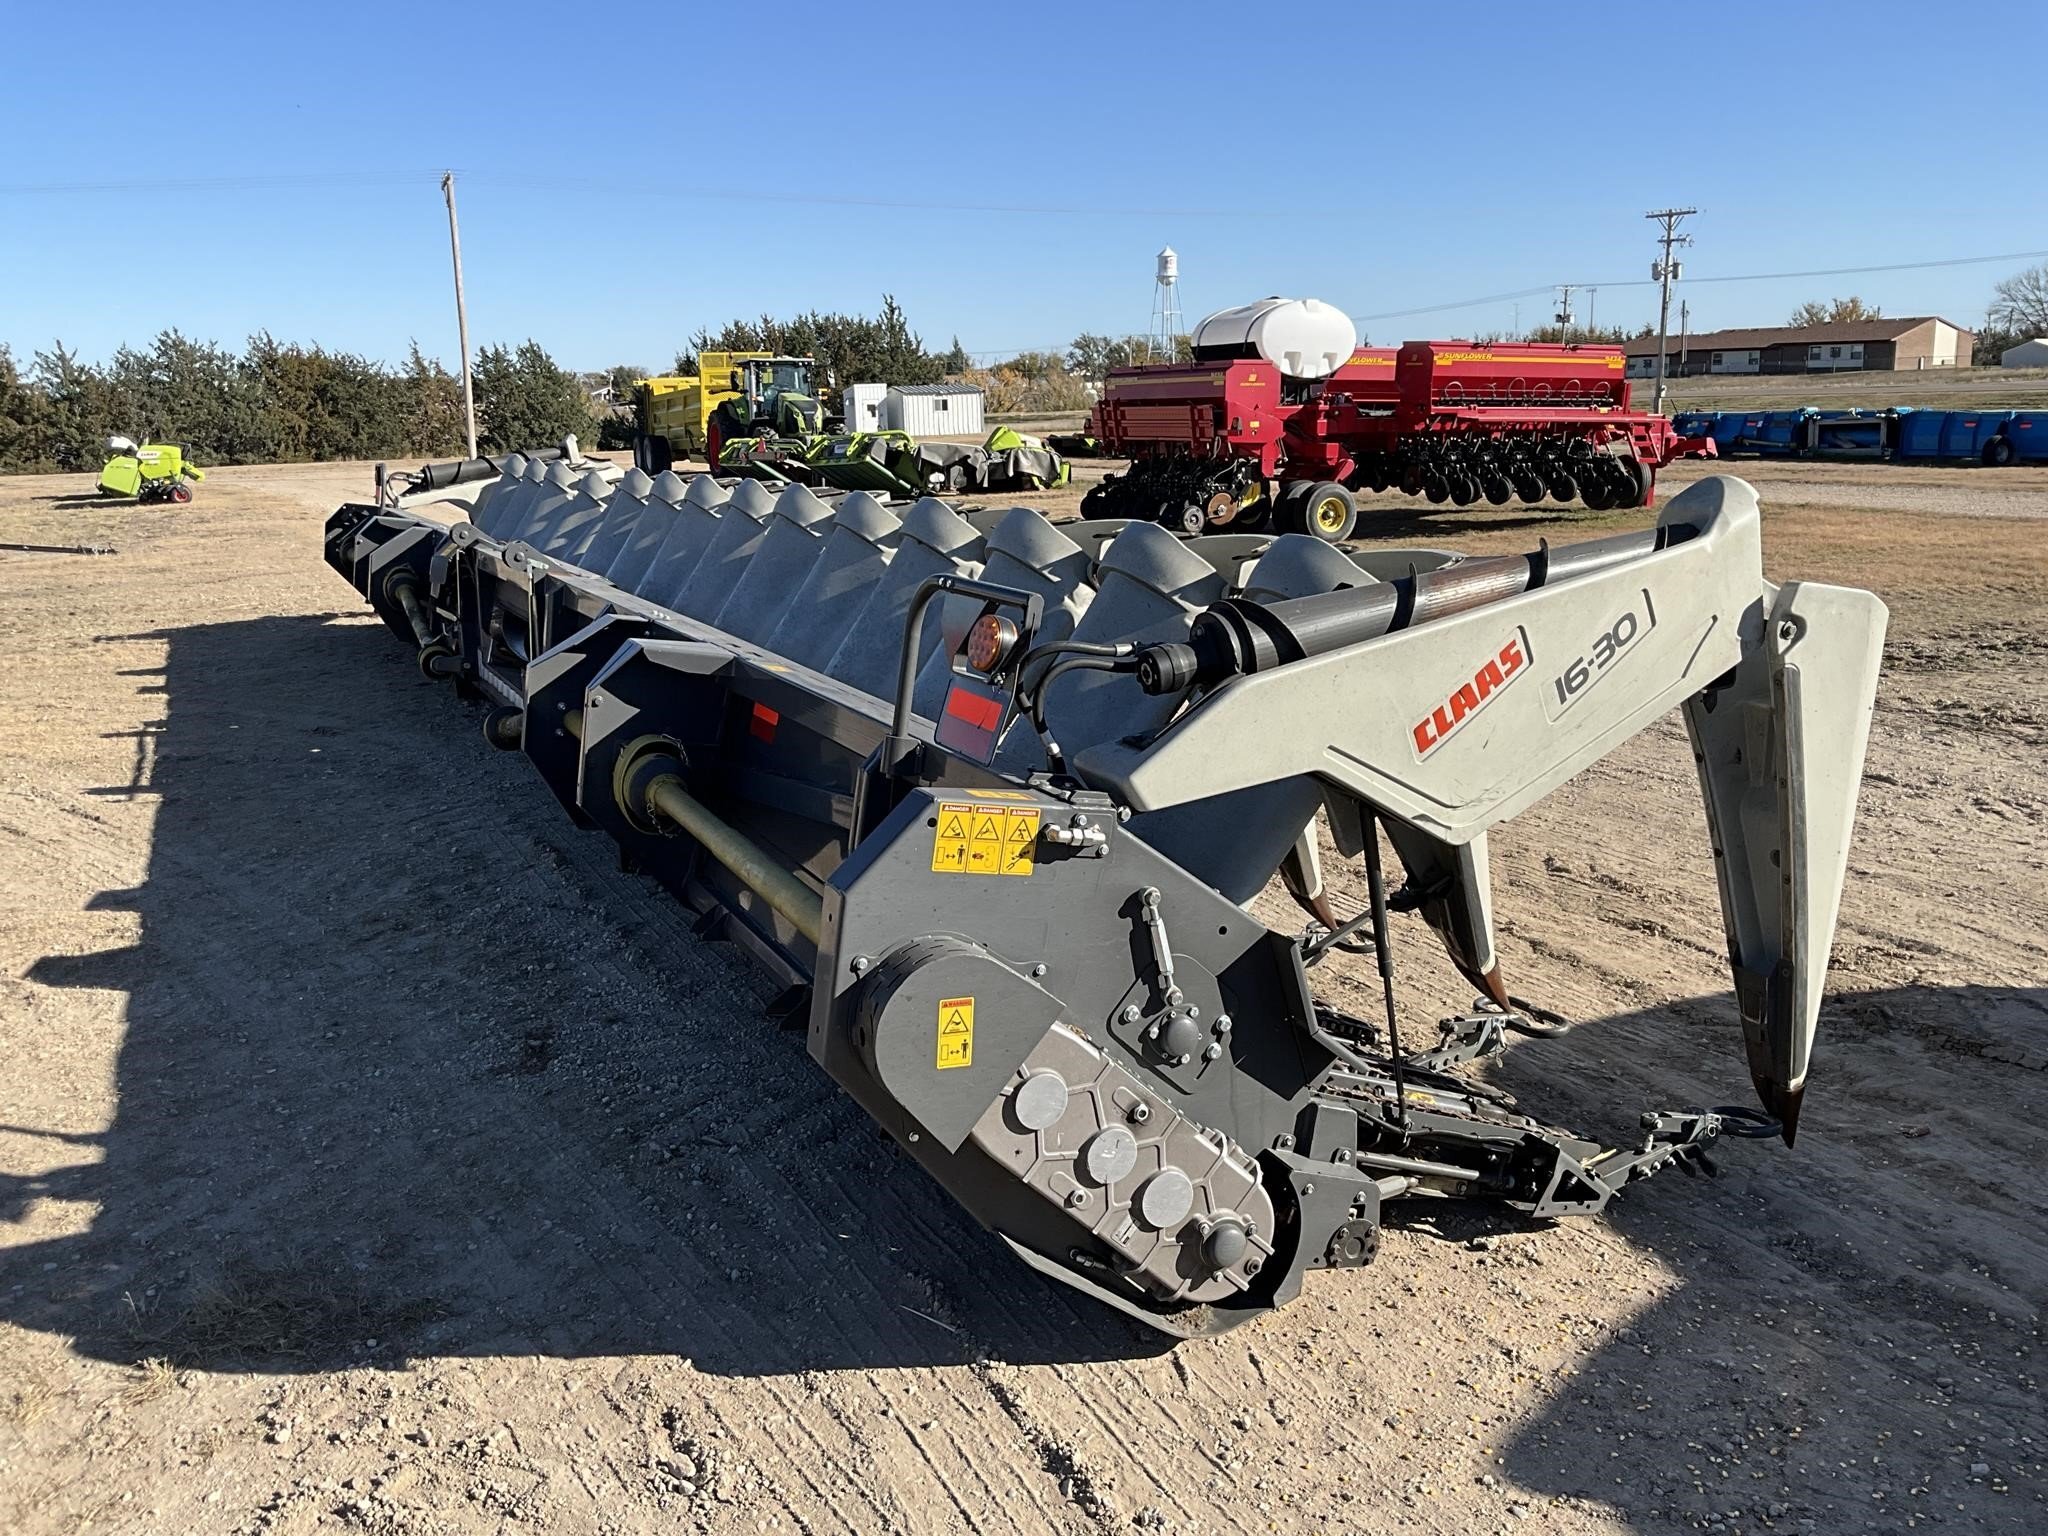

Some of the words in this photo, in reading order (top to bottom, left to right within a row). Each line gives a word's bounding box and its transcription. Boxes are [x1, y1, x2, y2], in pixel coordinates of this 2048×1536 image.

[1443, 352, 1493, 360] SUNFLOWER
[1413, 640, 1523, 753] CLAAS
[1555, 612, 1637, 705] 16-30
